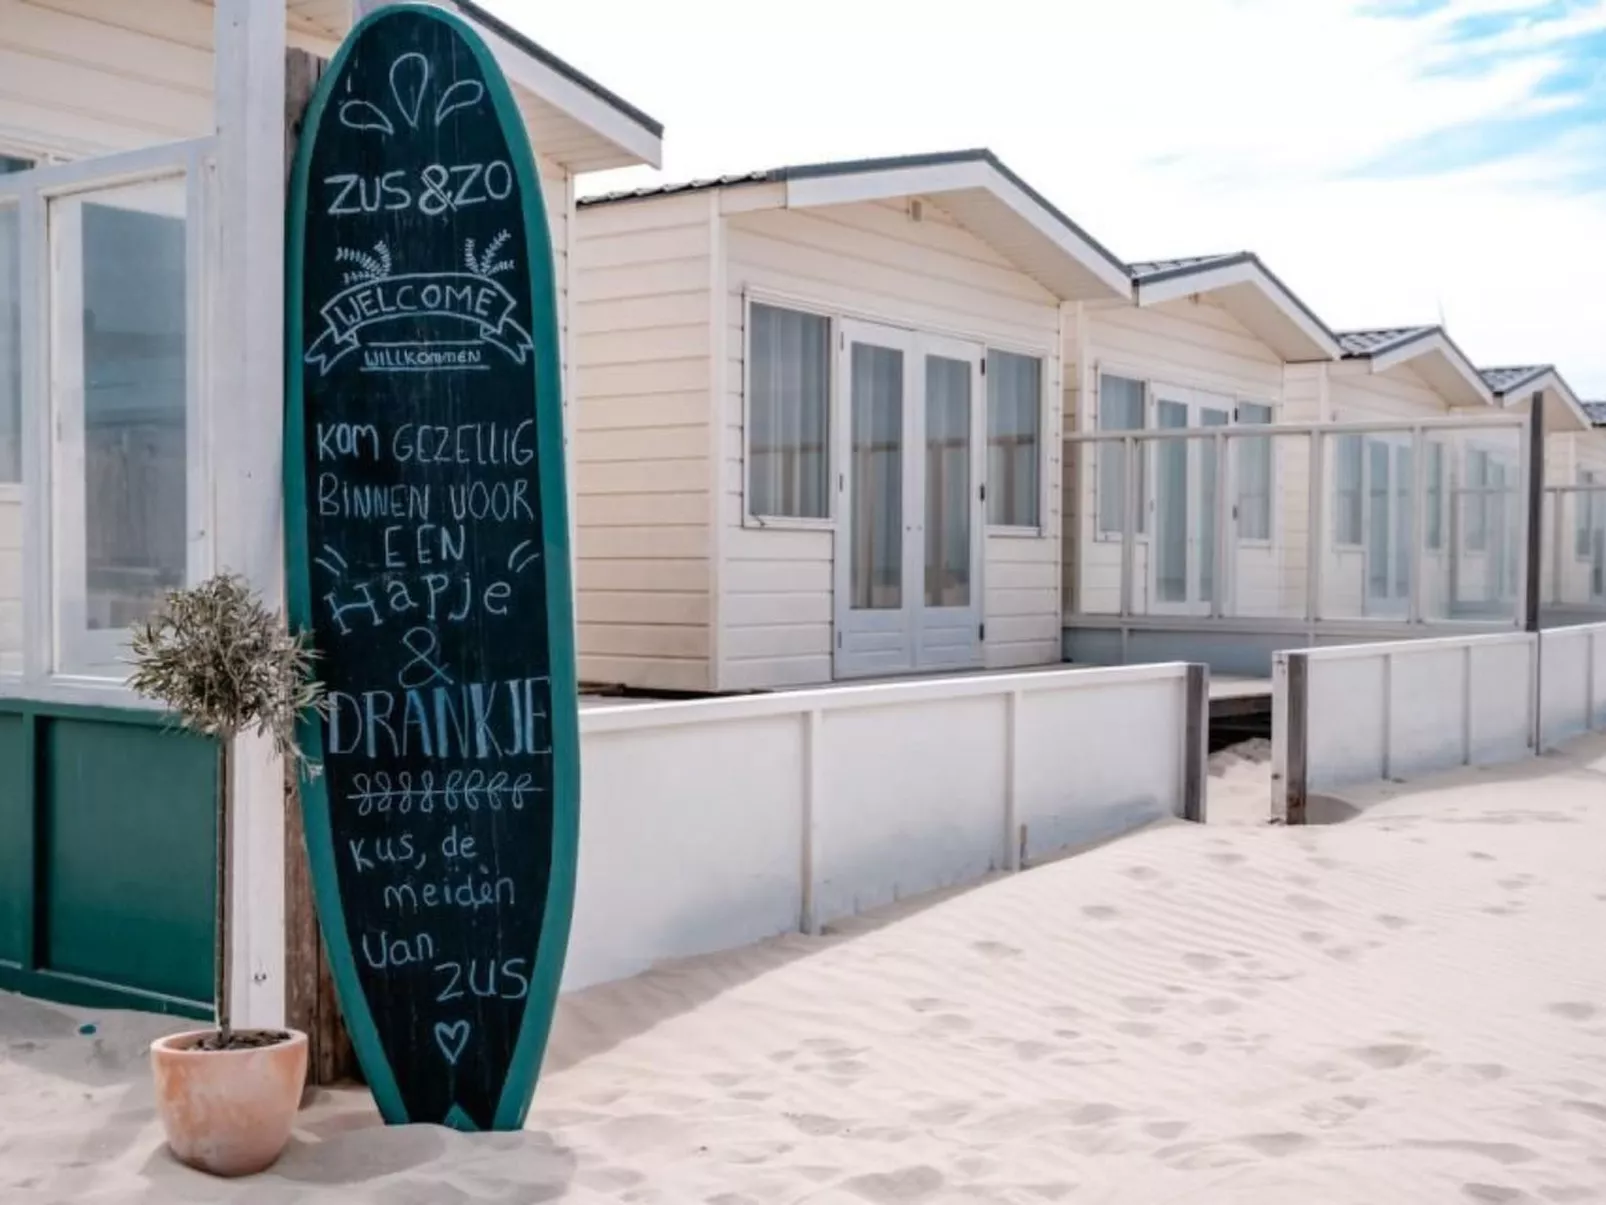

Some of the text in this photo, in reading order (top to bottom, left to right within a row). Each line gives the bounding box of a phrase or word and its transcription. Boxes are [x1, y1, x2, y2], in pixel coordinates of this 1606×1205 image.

[334, 284, 498, 328] WELCOME
[384, 524, 466, 568] EEN
[398, 626, 454, 688] &
[327, 676, 553, 760] DRANKJE
[441, 825, 480, 859] de
[383, 873, 515, 910] meiden
